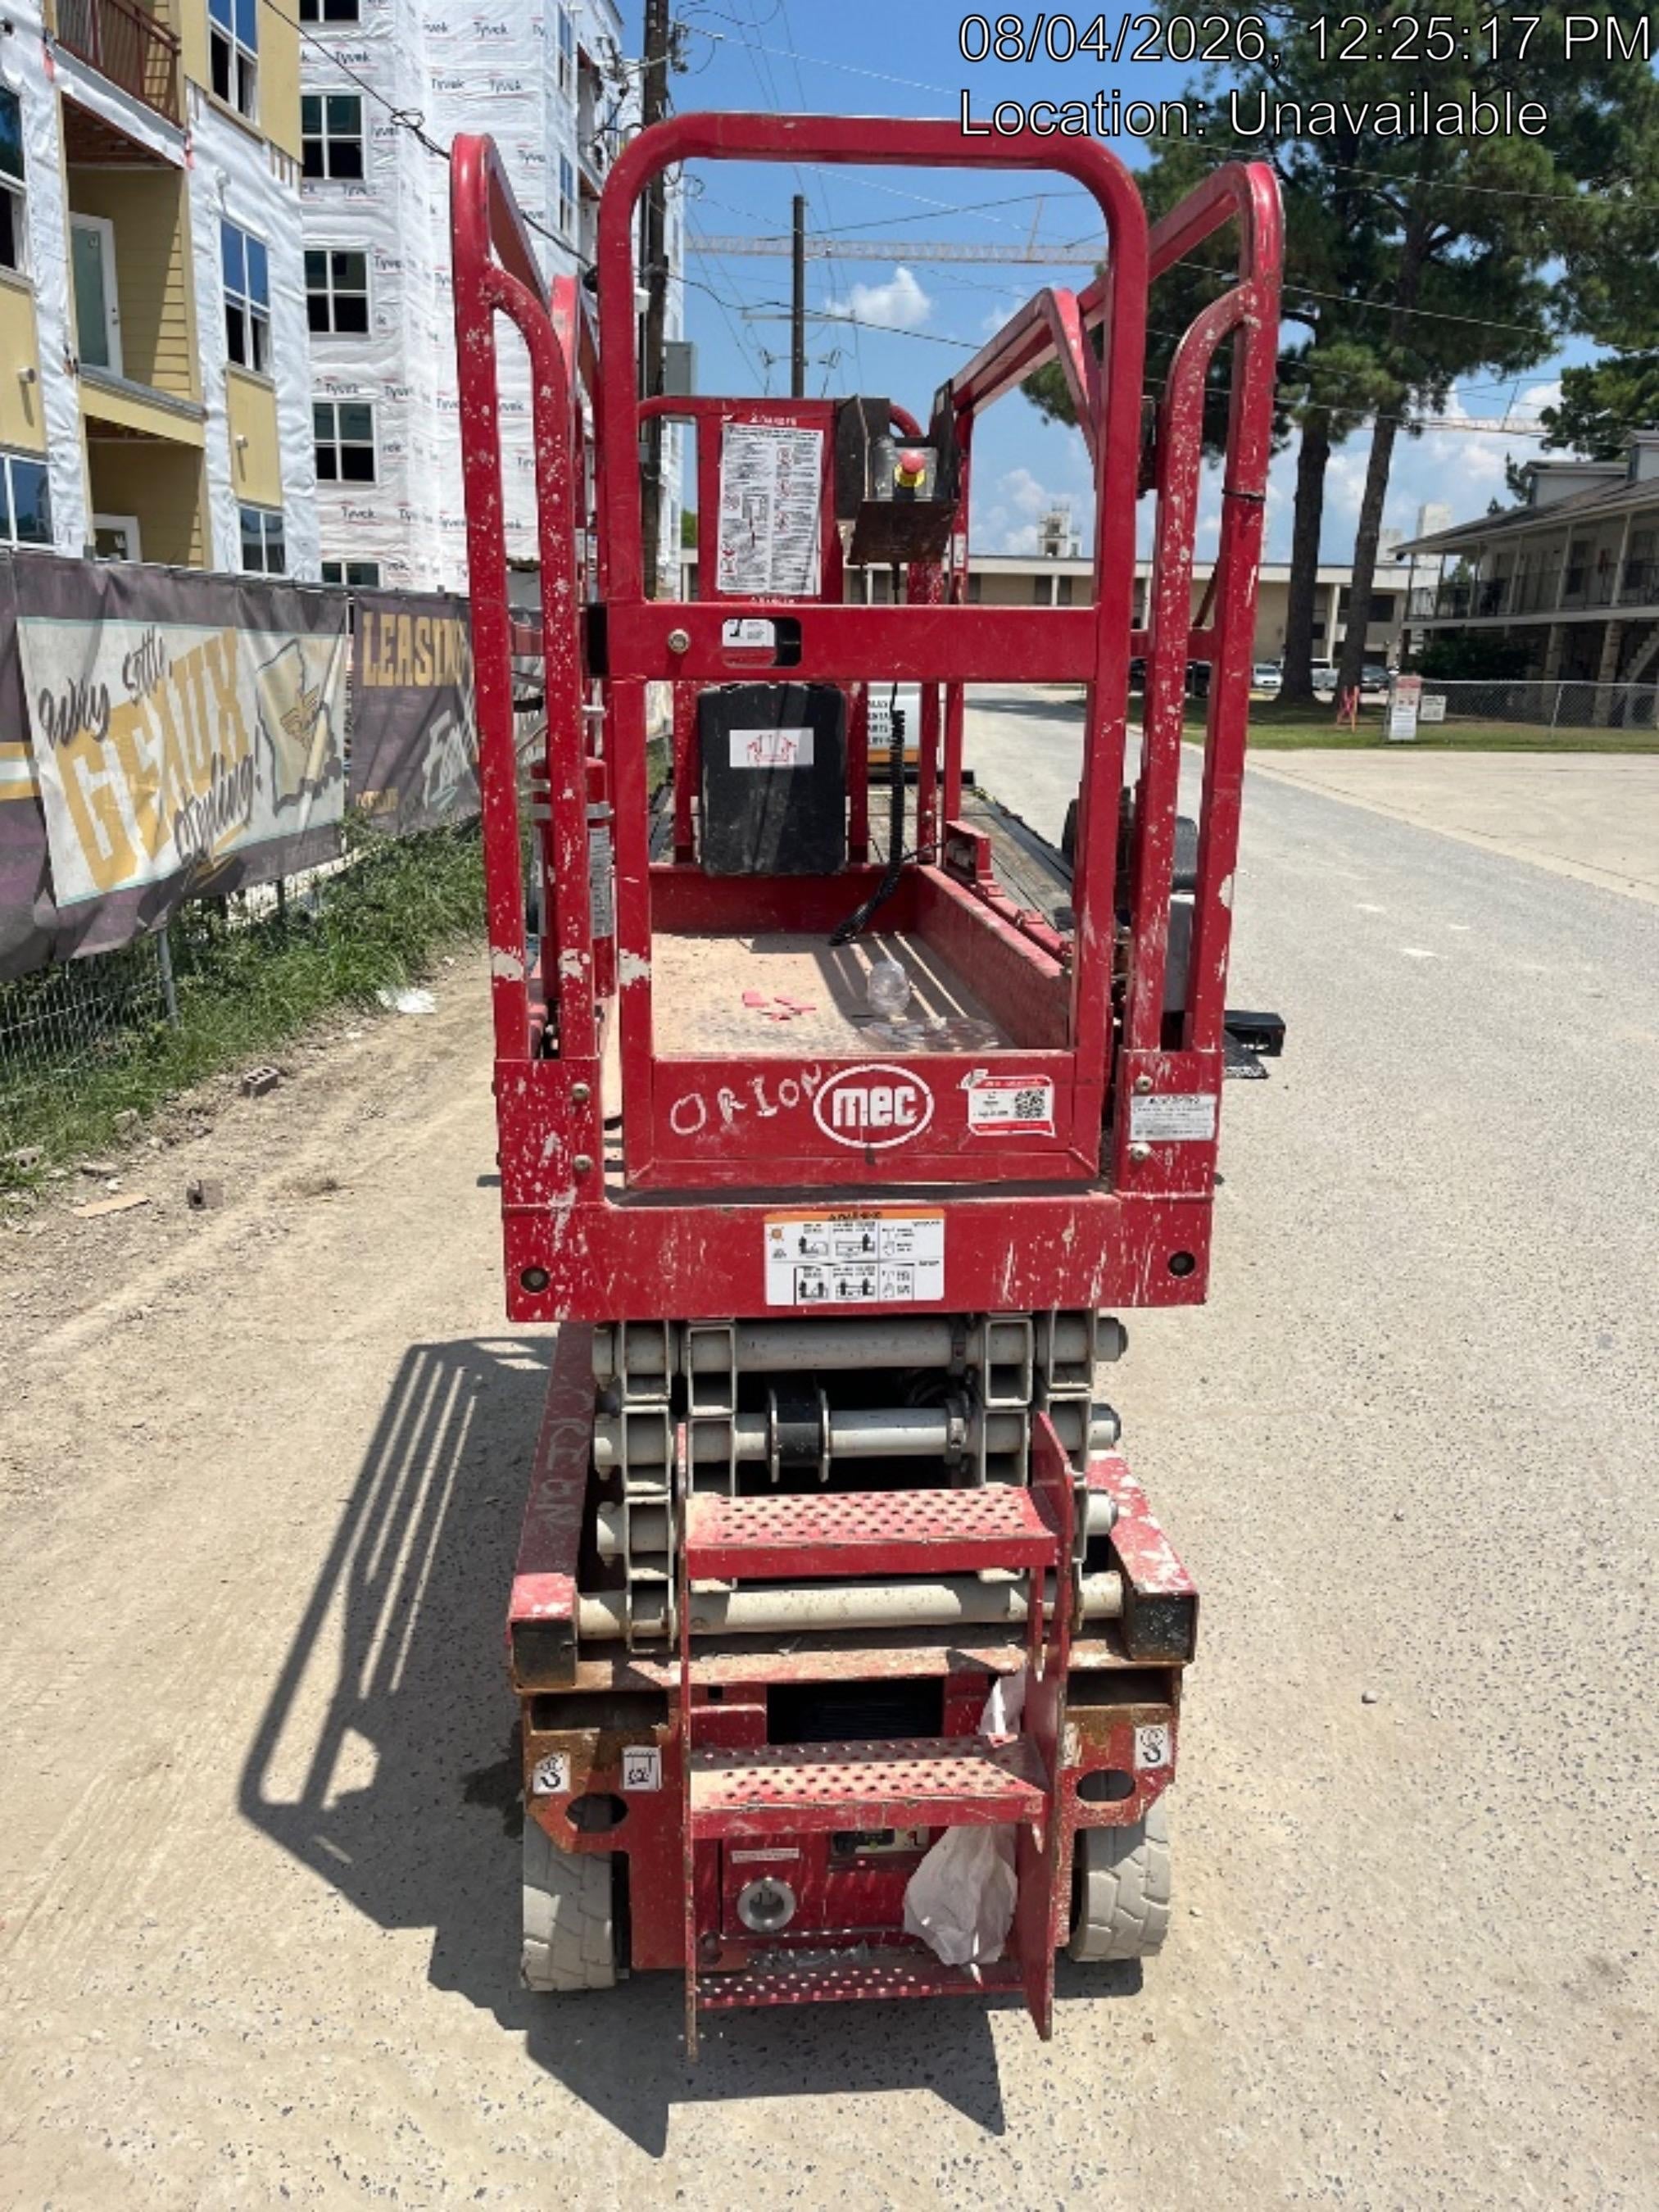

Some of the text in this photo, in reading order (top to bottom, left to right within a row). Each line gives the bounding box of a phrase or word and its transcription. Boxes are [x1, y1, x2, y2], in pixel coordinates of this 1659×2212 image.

[335, 51, 371, 65] Tyvek
[56, 625, 251, 891] GEAUX
[670, 1064, 822, 1135] ORION
